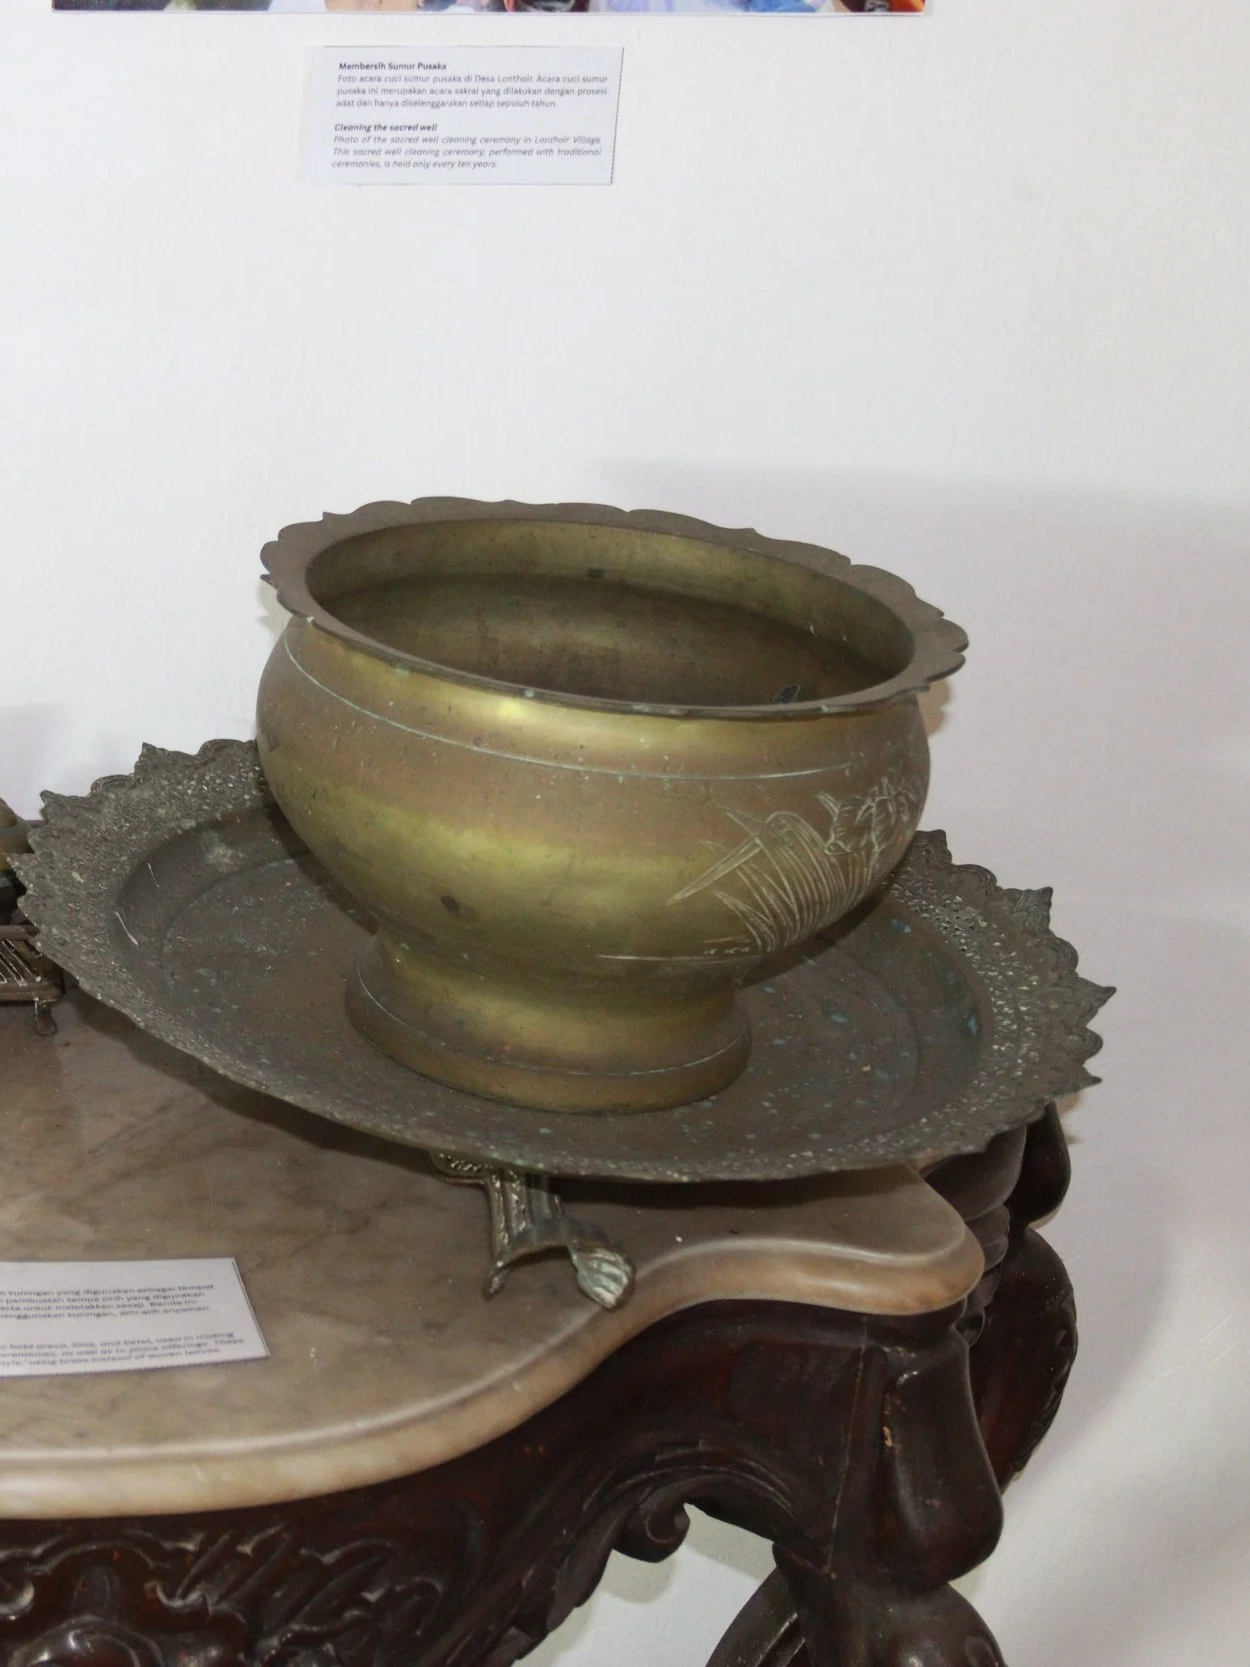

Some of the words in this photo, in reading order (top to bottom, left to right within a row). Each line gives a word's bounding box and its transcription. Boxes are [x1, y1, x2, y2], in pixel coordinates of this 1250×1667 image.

[339, 62, 386, 70] Membersih
[388, 62, 415, 70] Sumur
[417, 62, 447, 70] Pusaka
[338, 75, 357, 83] Foto
[384, 75, 402, 83] cuci
[432, 75, 461, 84] pusaka
[464, 75, 472, 83] di
[474, 75, 495, 83] Desa
[536, 75, 560, 83] Acara
[562, 75, 580, 83] cuci
[337, 87, 366, 97] pusaka
[368, 87, 379, 95] ini
[380, 87, 427, 97] merupakan
[454, 87, 478, 95] sakral
[481, 89, 501, 97] yang
[504, 87, 542, 95] dilakukan
[544, 87, 575, 97] dengan
[577, 87, 607, 97] prosesi
[336, 99, 354, 107] adat
[356, 99, 372, 107] dan
[374, 99, 399, 109] hanya
[401, 99, 467, 109] diselenggarakan
[469, 99, 494, 109] setiap
[497, 99, 529, 109] sepuluh
[334, 123, 372, 133] Cleaning
[373, 123, 387, 131] the
[389, 123, 419, 131] sacred
[420, 123, 438, 131] well
[334, 135, 358, 144] Photo
[361, 135, 371, 144] of
[373, 135, 387, 144] the
[390, 135, 419, 144] sacred
[422, 135, 439, 144] well
[441, 135, 477, 145] cleaning
[480, 137, 521, 145] ceremony
[523, 135, 532, 144] in
[534, 135, 570, 144] Lonthoir
[333, 148, 350, 156] This
[353, 148, 382, 156] sacred
[385, 148, 402, 156] well
[404, 148, 440, 157] cleaning
[488, 148, 533, 157] performed
[536, 148, 554, 156] with
[557, 148, 602, 156] traditional
[384, 160, 391, 168] is
[392, 160, 411, 168] held
[412, 160, 430, 169] only
[457, 160, 471, 168] ten
